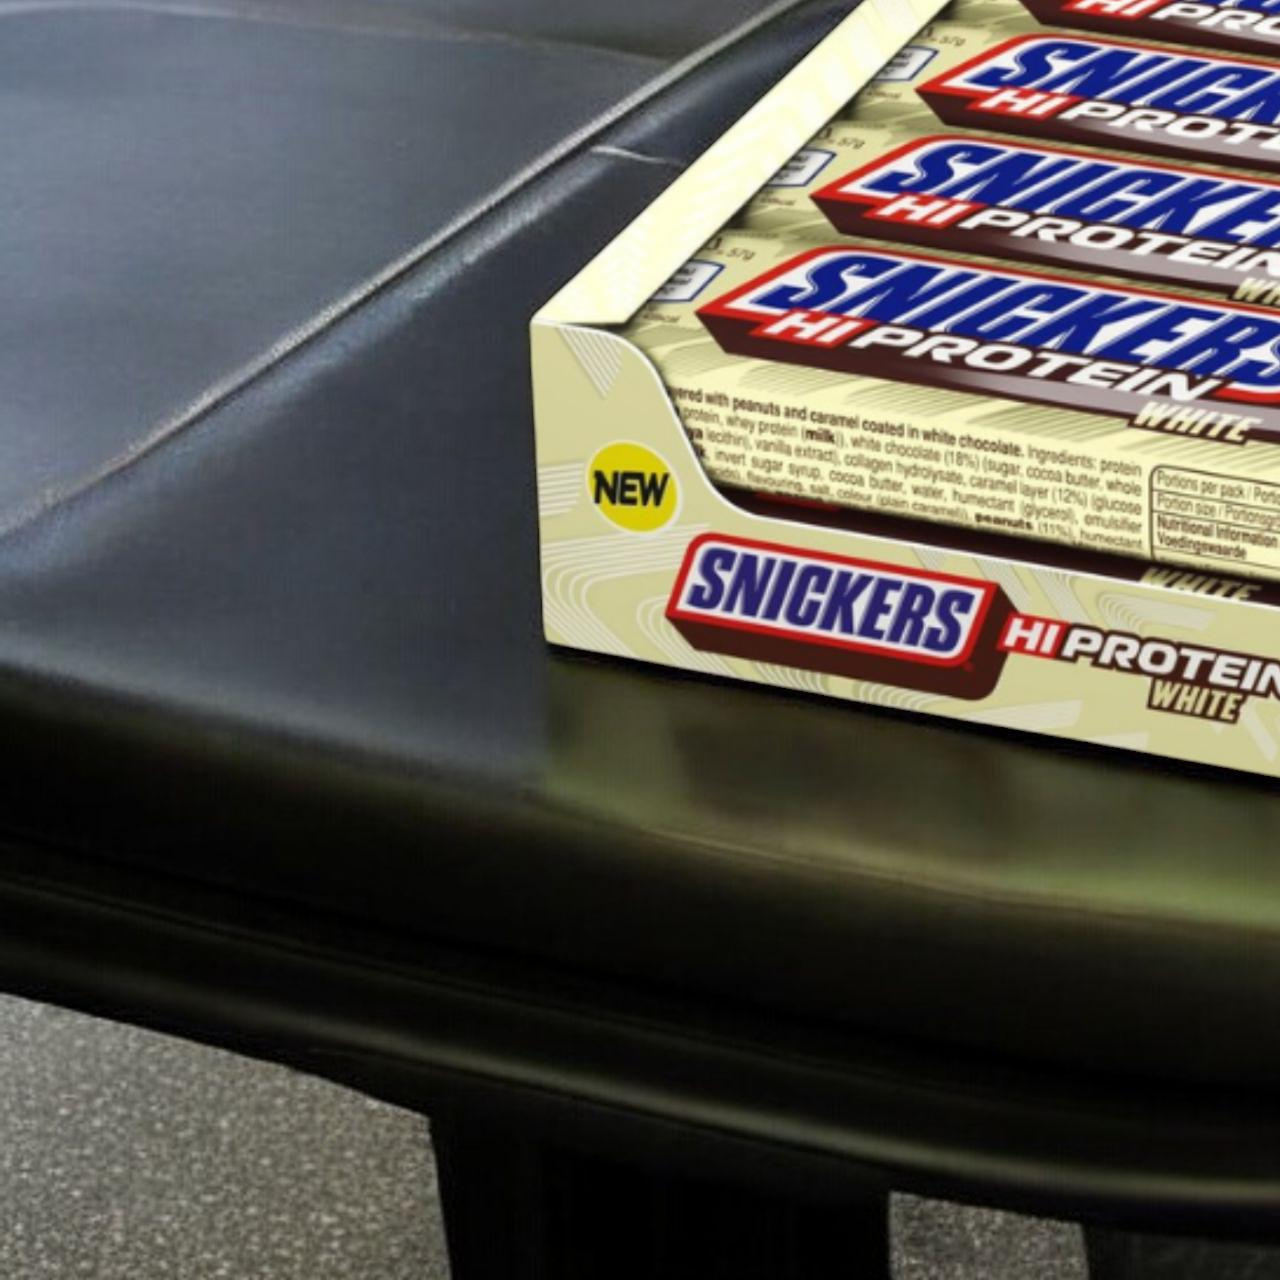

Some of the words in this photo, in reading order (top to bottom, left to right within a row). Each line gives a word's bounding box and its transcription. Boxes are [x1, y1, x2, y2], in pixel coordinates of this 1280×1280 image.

[977, 86, 1072, 115] HI
[876, 193, 977, 224] HI
[764, 310, 866, 343] HI
[848, 326, 1225, 402] PROTEIN
[705, 391, 729, 408] with
[733, 397, 781, 416] peanuts
[784, 405, 807, 421] and
[810, 410, 860, 428] caramel
[862, 418, 905, 437] coated
[907, 424, 920, 439] in
[922, 428, 956, 445] white
[959, 434, 1025, 457] chocolate.
[1028, 444, 1097, 470] Ingredients:
[1100, 460, 1142, 477] protein
[1133, 401, 1264, 444] WHITE
[726, 416, 755, 434] whey
[758, 421, 799, 436] protein
[851, 436, 881, 452] white
[884, 441, 942, 462] chocolate
[944, 450, 980, 470] (18%)
[1026, 466, 1063, 482] cocoa
[1106, 479, 1142, 496] whole
[755, 438, 792, 456] vanilla
[844, 453, 894, 472] collagen
[969, 475, 1018, 494] caramel
[1020, 481, 1049, 500] layer
[1051, 487, 1088, 509] (12%)
[593, 469, 671, 507] NEW
[715, 448, 746, 466] invert
[751, 456, 784, 473] sugar
[829, 470, 865, 487] cocoa
[952, 489, 1016, 513] humectant
[1083, 513, 1142, 534] emulsifier
[836, 488, 873, 503] colour
[1156, 469, 1199, 492] Portions
[1200, 480, 1218, 495] per
[1220, 483, 1246, 500] pack
[1156, 491, 1195, 513] Portion
[1156, 515, 1215, 537] Nutritional
[1216, 522, 1279, 549] Information
[688, 547, 975, 653] SNICKERS
[1002, 617, 1063, 654] HI
[1151, 679, 1245, 722] WHITE
